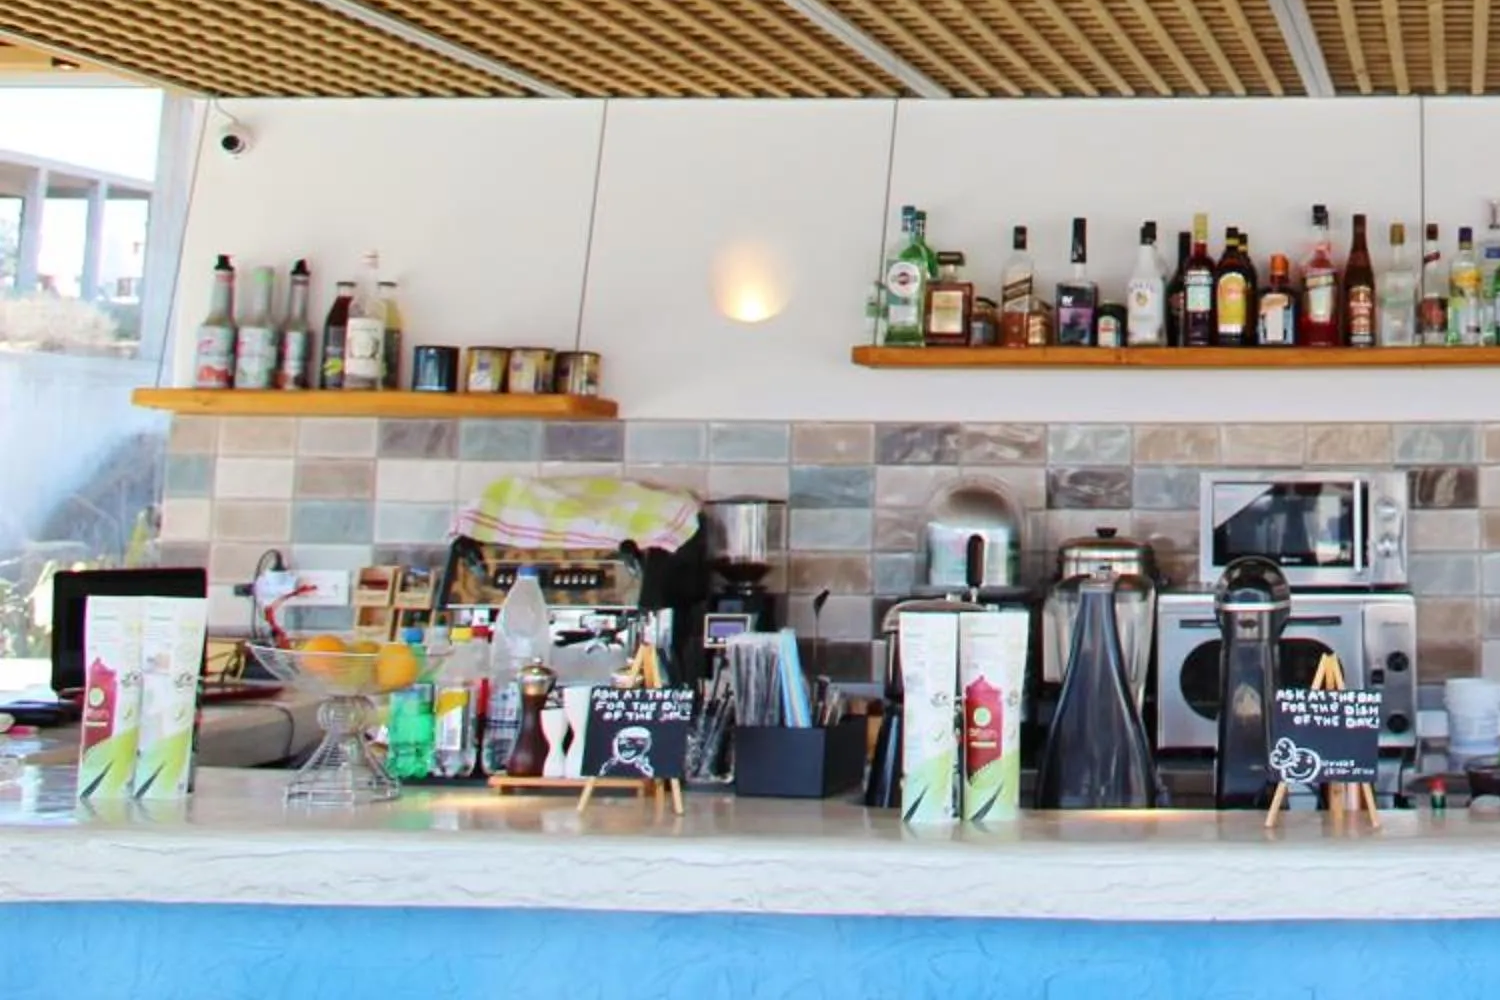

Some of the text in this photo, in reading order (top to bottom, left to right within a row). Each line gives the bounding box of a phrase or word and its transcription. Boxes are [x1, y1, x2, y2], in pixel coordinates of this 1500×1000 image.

[623, 689, 640, 700] AT
[1276, 688, 1306, 701] ASK
[1308, 691, 1325, 702] AT
[1328, 692, 1356, 703] THE
[595, 700, 625, 711] FOR
[632, 701, 657, 712] THE
[1281, 702, 1379, 716] FOR THE DISH
[624, 711, 654, 721] THE
[1293, 714, 1311, 725] OF
[1313, 715, 1340, 727] THE
